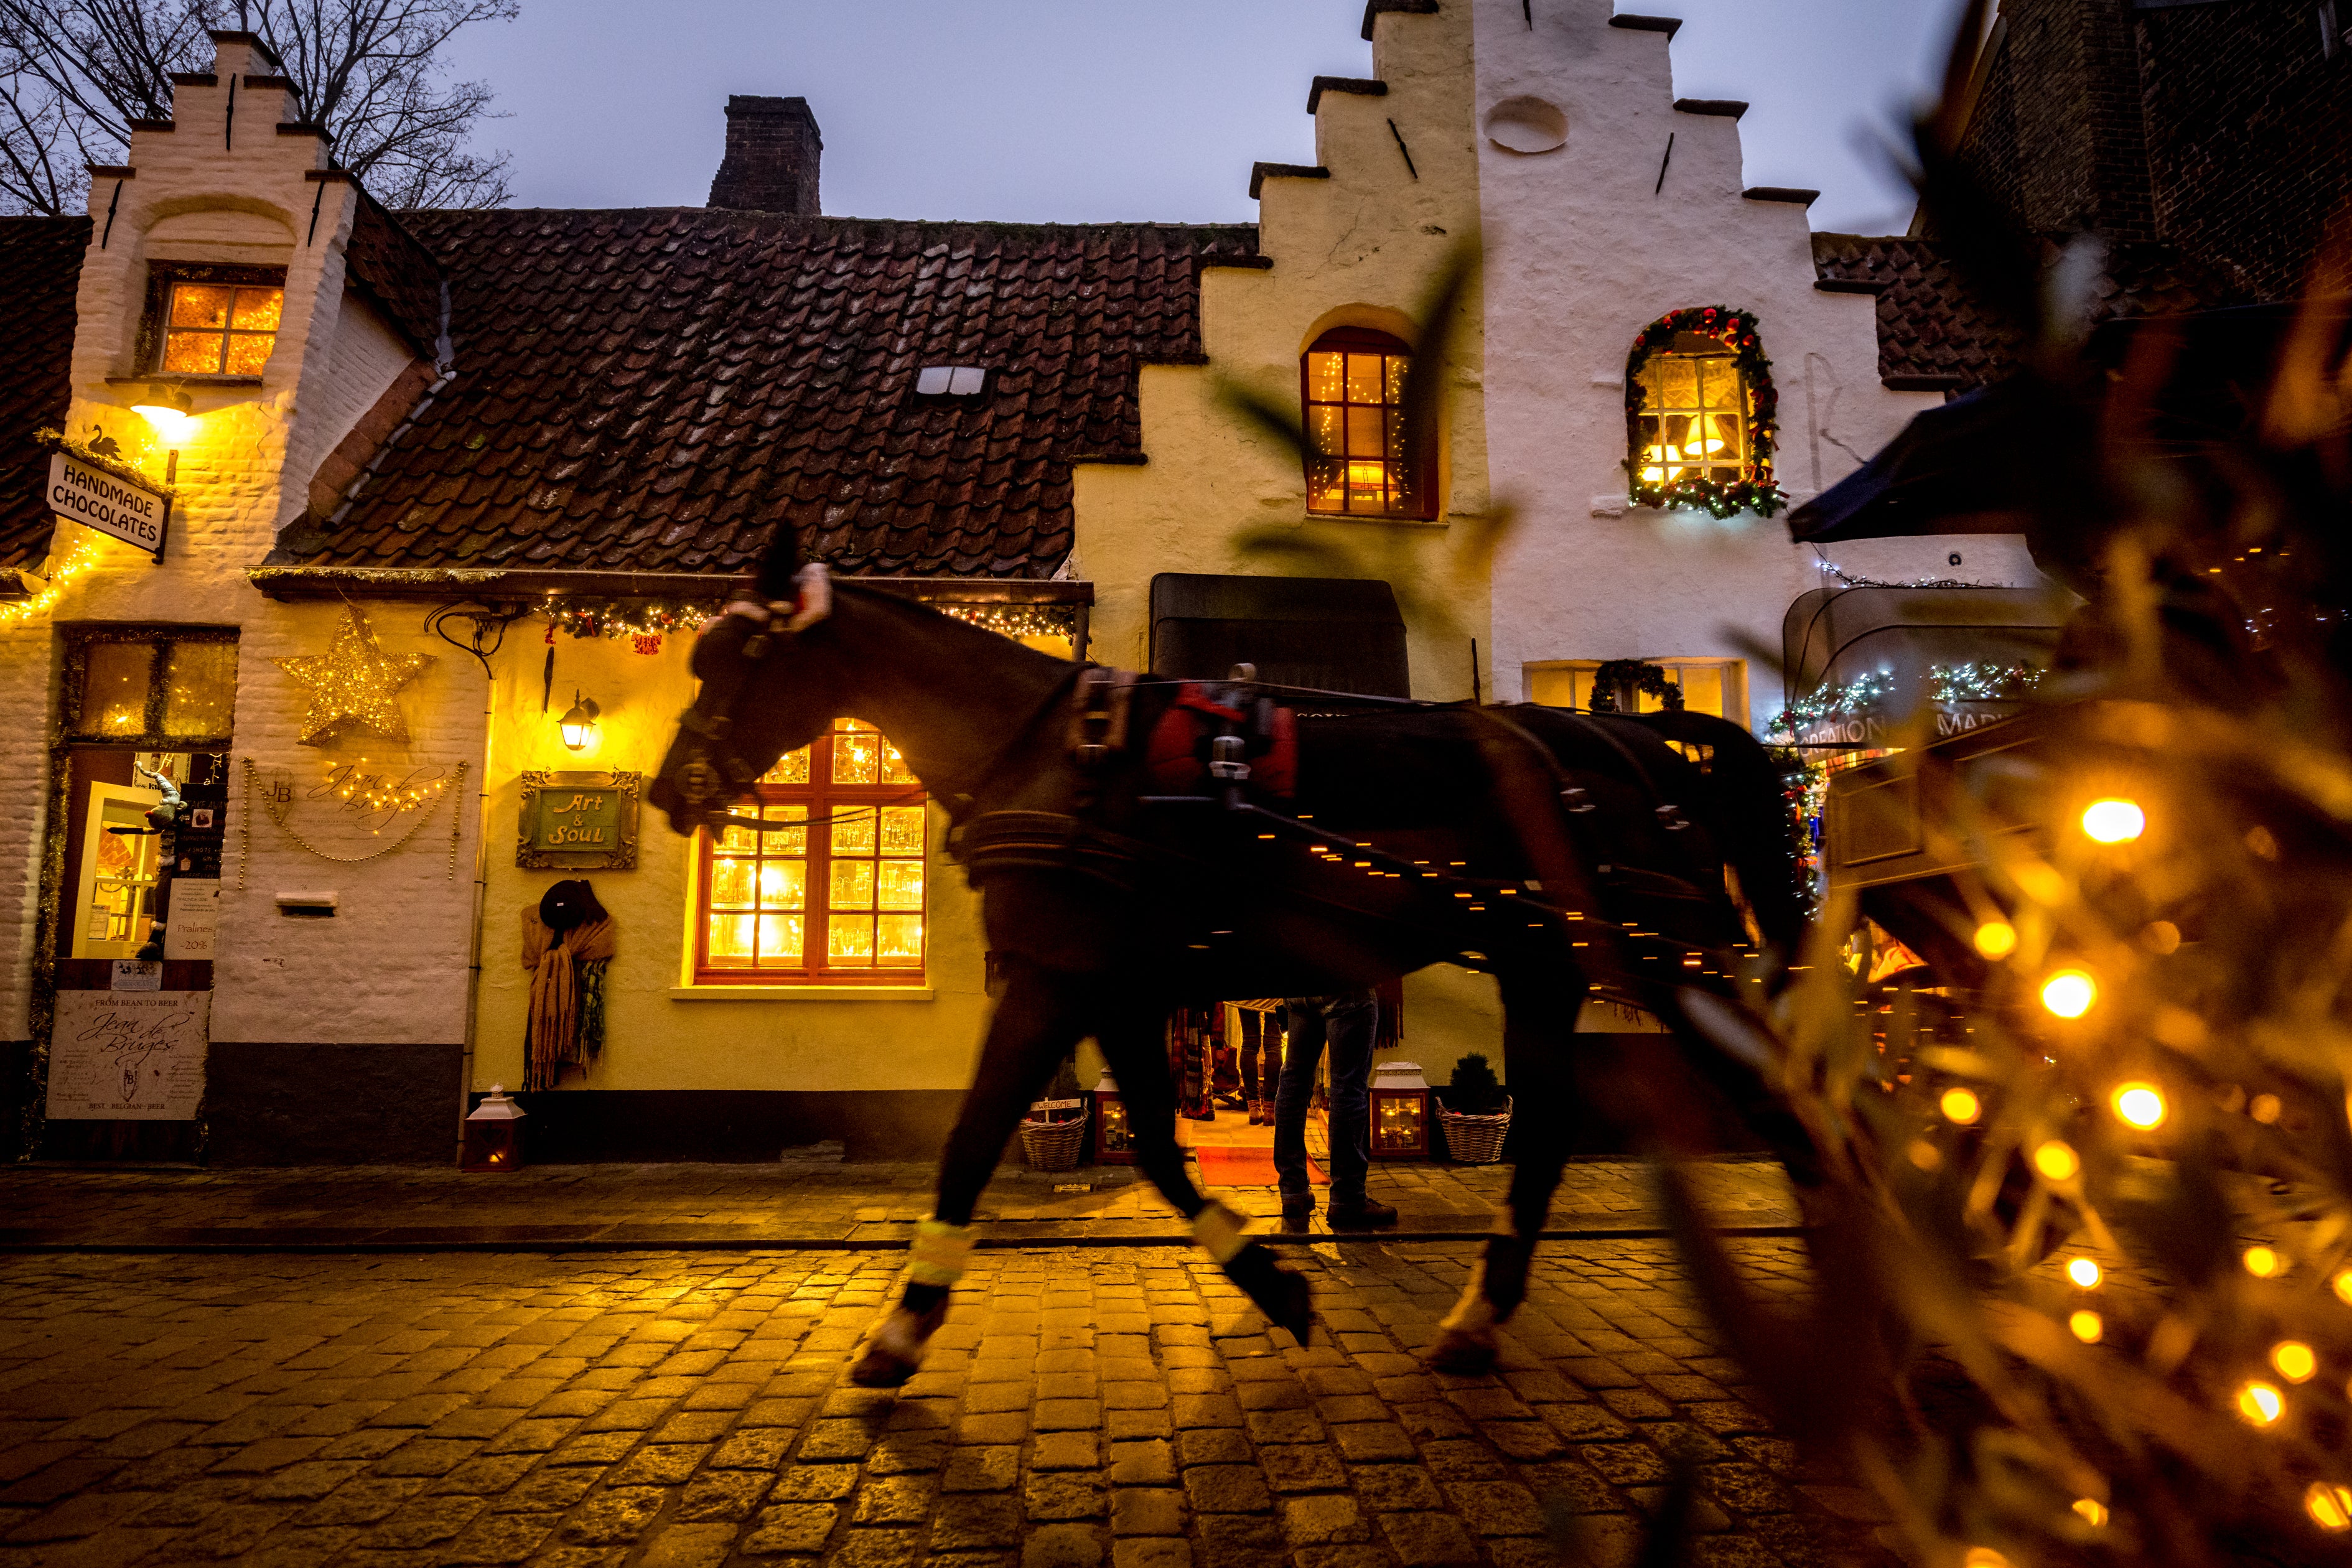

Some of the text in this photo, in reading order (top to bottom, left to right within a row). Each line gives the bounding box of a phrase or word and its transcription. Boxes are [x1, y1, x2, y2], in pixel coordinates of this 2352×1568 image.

[63, 464, 154, 519] HANDMADE
[53, 485, 156, 542] CHOCOLATES
[631, 632, 662, 645] MERRY
[633, 644, 660, 655] XMAS
[553, 794, 603, 813] Art
[573, 814, 583, 826] &
[177, 922, 213, 933] Pralines
[180, 940, 208, 950] -20%
[77, 1012, 190, 1042] Jean de
[95, 1033, 179, 1065] Bruges
[1037, 1100, 1071, 1109] WELCOME
